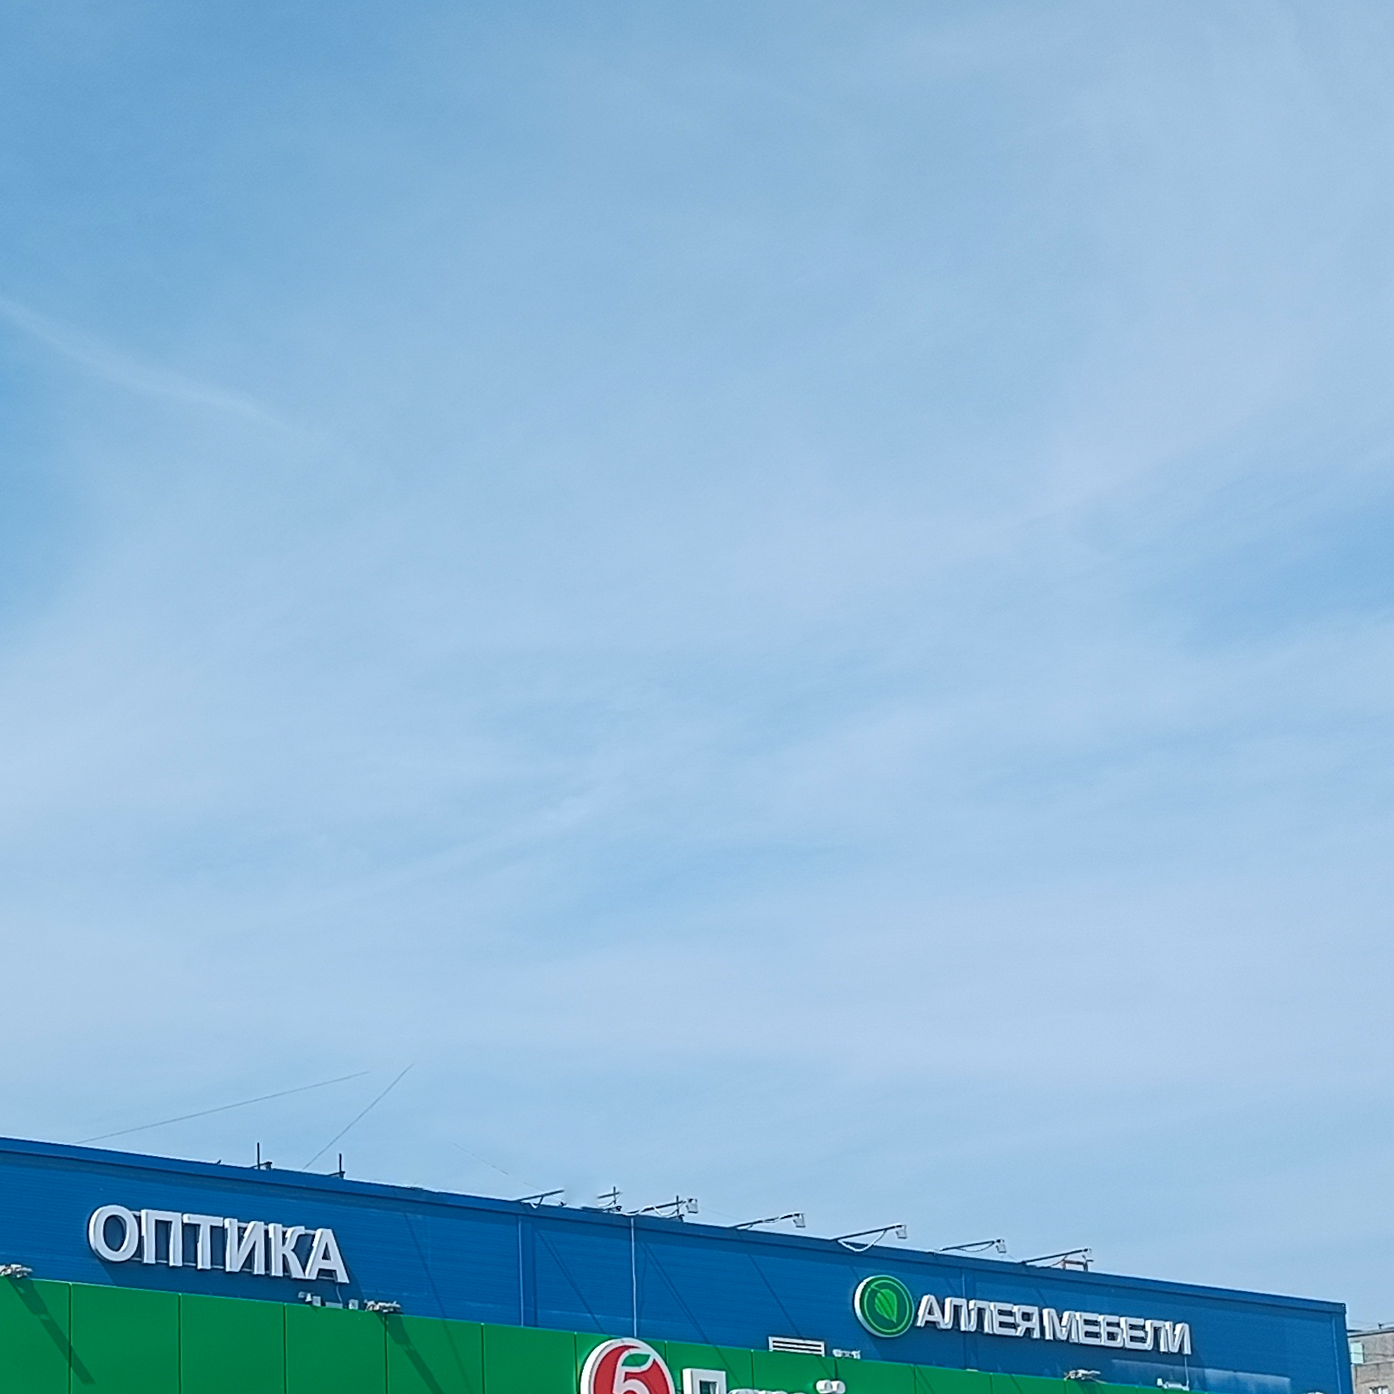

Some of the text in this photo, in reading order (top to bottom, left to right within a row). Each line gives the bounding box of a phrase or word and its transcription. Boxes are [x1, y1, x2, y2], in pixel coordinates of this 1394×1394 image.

[89, 1205, 350, 1283] ОПТИКА
[915, 1294, 1192, 1354] АЛЛЕЯ МЕБЕЛИ
